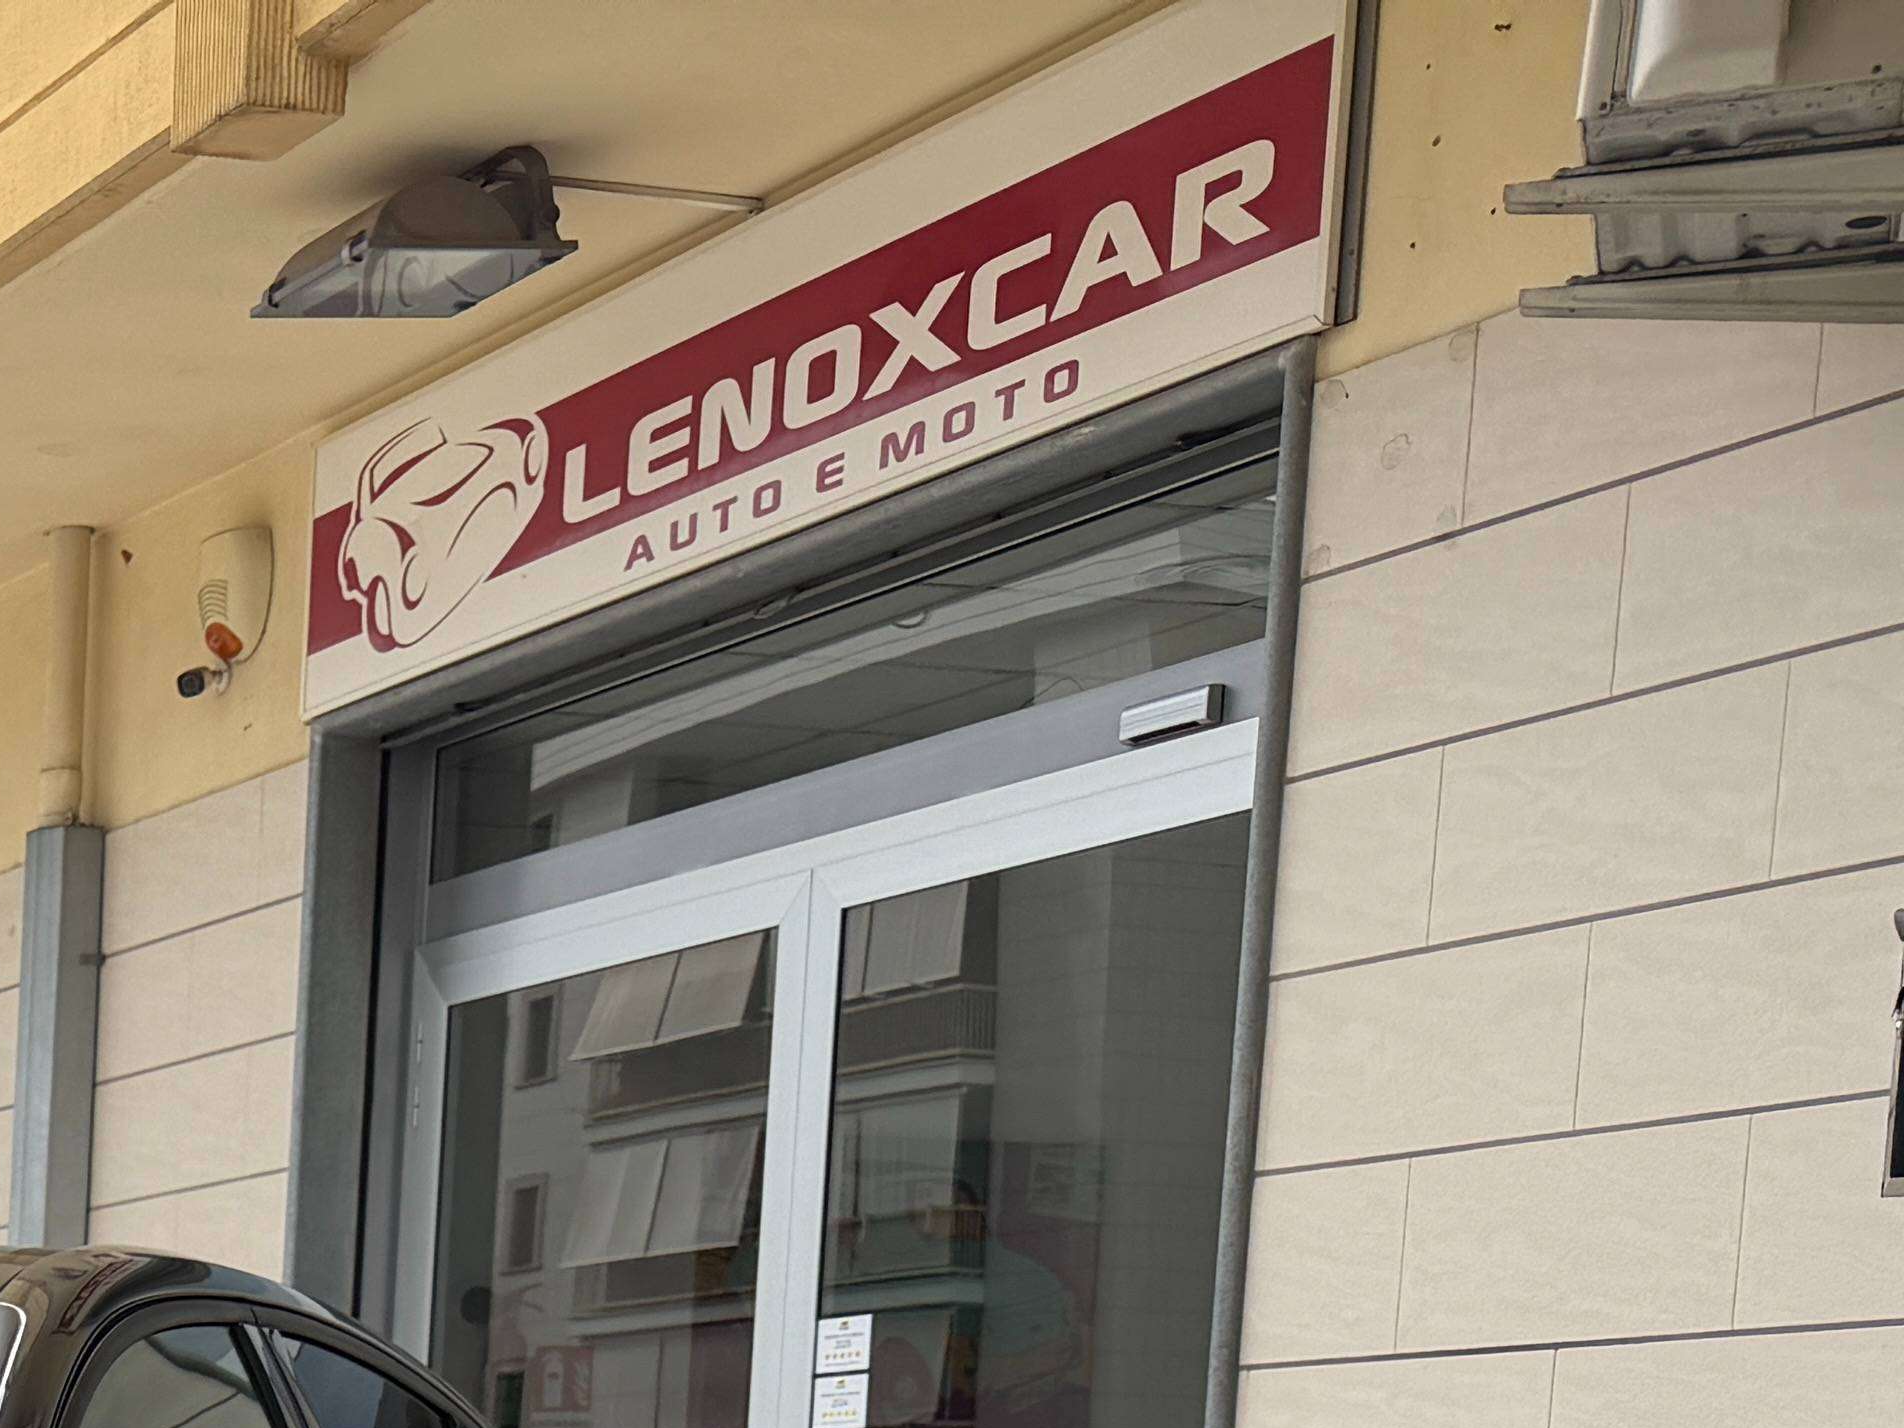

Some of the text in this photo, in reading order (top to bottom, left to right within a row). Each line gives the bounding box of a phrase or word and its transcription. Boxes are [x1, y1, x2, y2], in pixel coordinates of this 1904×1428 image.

[561, 138, 1275, 525] LENOXCAR
[623, 358, 1081, 571] AUTO E MOTO
